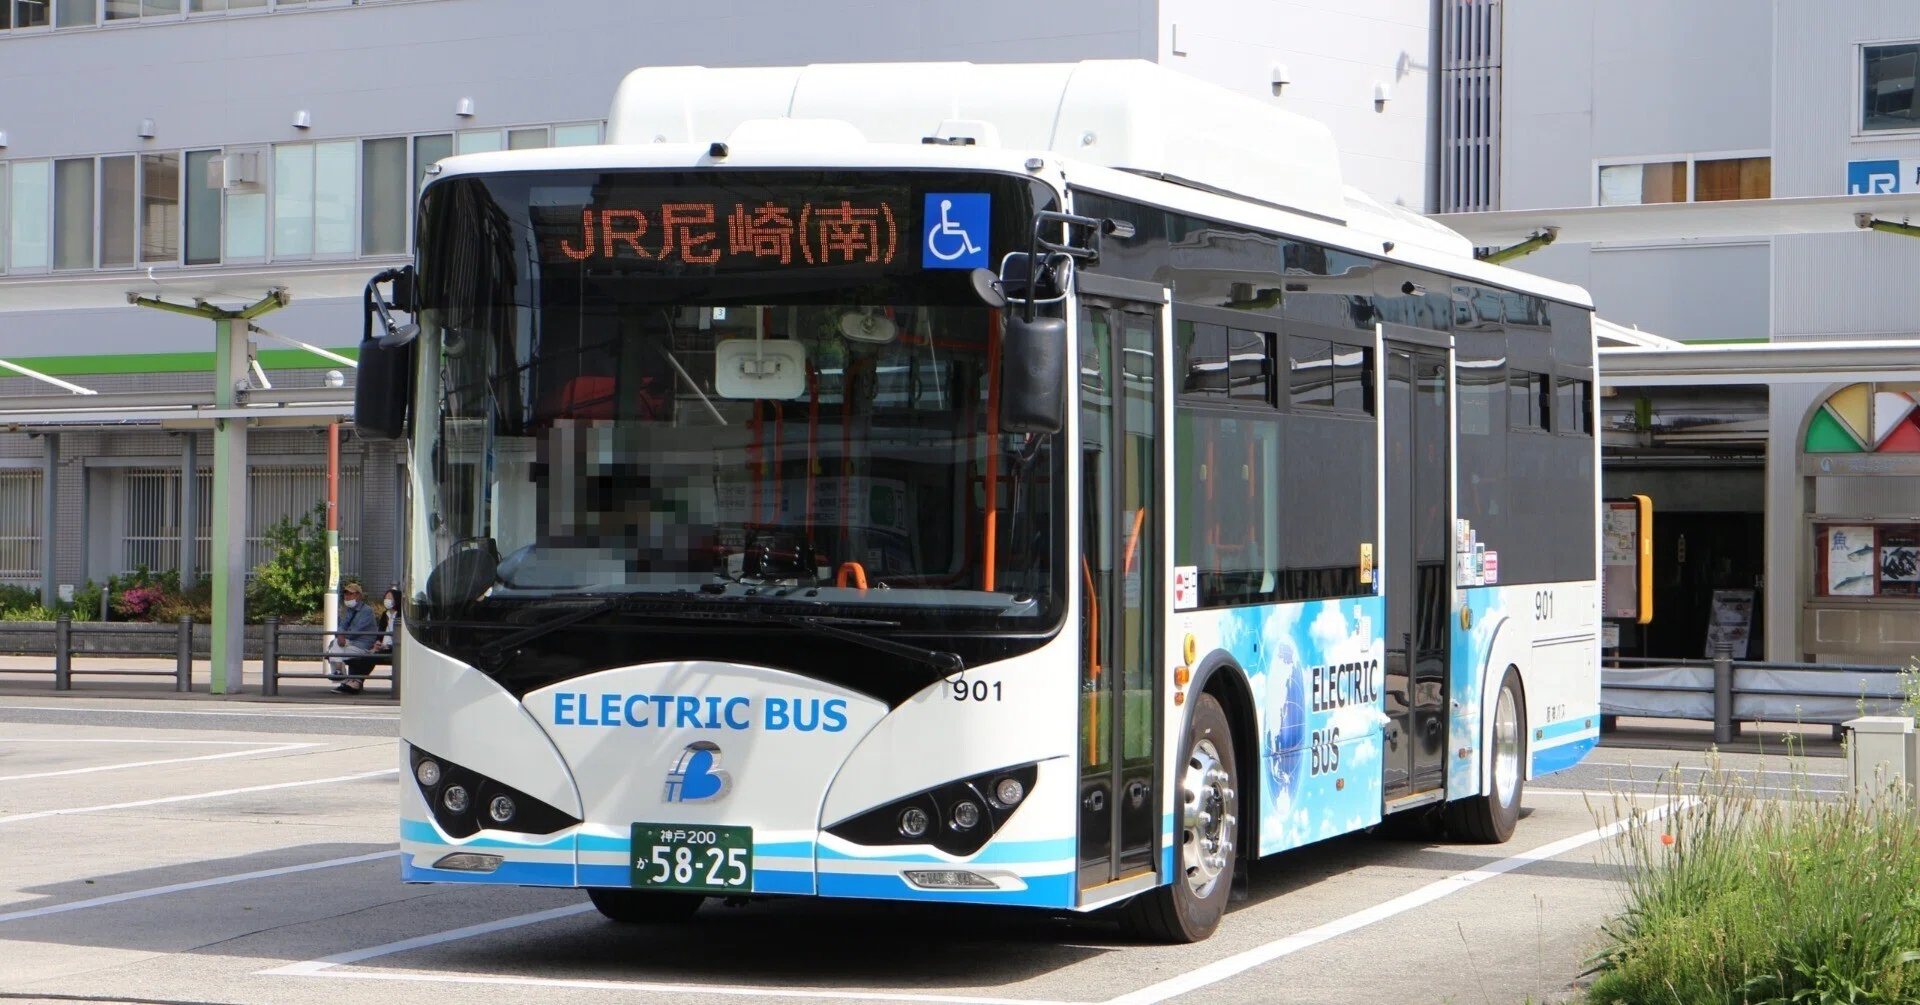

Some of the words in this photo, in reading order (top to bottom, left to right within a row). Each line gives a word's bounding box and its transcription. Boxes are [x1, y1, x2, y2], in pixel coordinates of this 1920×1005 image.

[1852, 173, 1896, 195] JR
[561, 201, 897, 264] JR尼崎(南)
[1831, 529, 1849, 551] 魚
[1535, 591, 1554, 620] 901
[953, 681, 1004, 702] 901
[1312, 659, 1378, 712] ELECTRIC
[554, 693, 750, 730] ELECTRIC
[765, 698, 848, 732] BUS
[1311, 727, 1340, 776] BUS
[660, 829, 717, 845] 神戸200
[636, 857, 649, 870] か
[652, 845, 747, 886] 58-25
